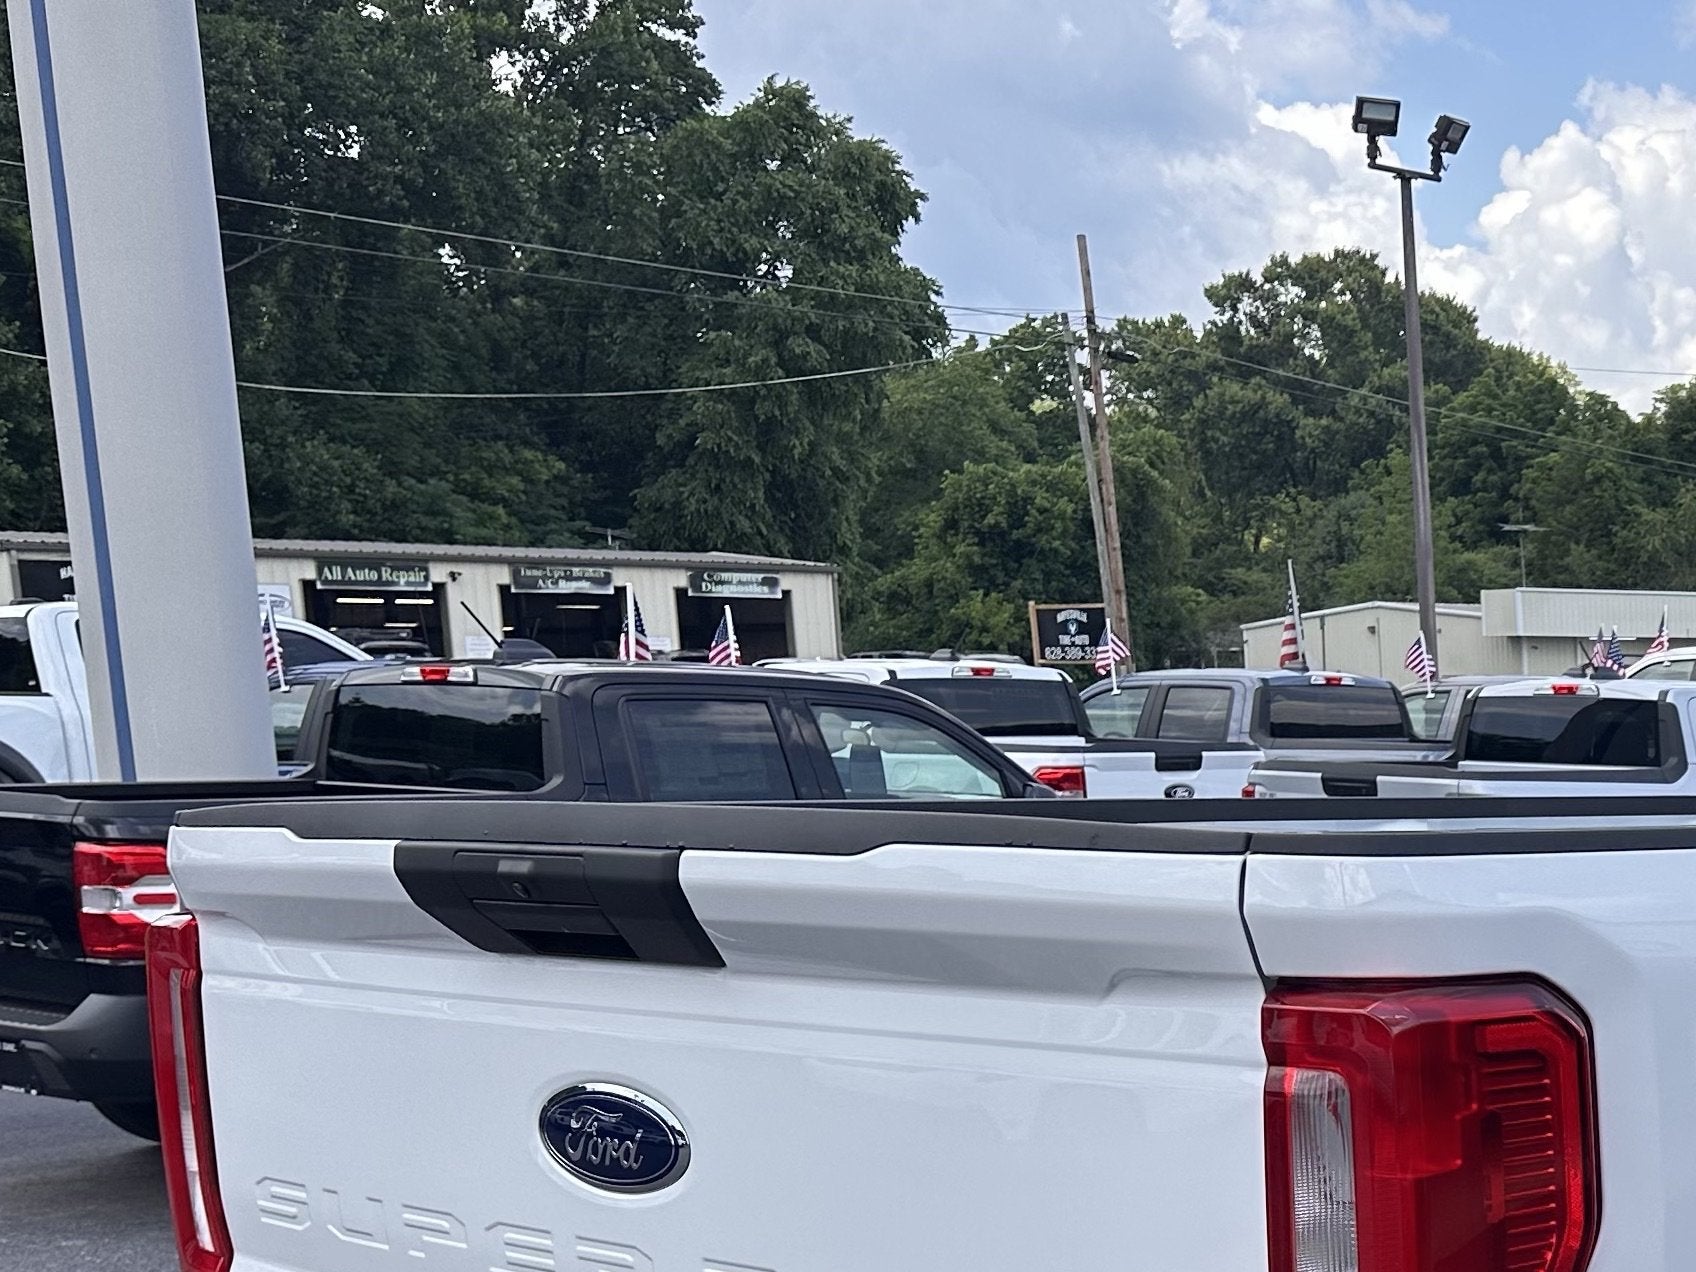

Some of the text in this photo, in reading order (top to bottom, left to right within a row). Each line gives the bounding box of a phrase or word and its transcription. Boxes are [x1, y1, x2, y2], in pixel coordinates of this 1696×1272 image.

[321, 565, 427, 586] All Auto Repair
[703, 571, 762, 585] Computer
[564, 1105, 644, 1171] Ford
